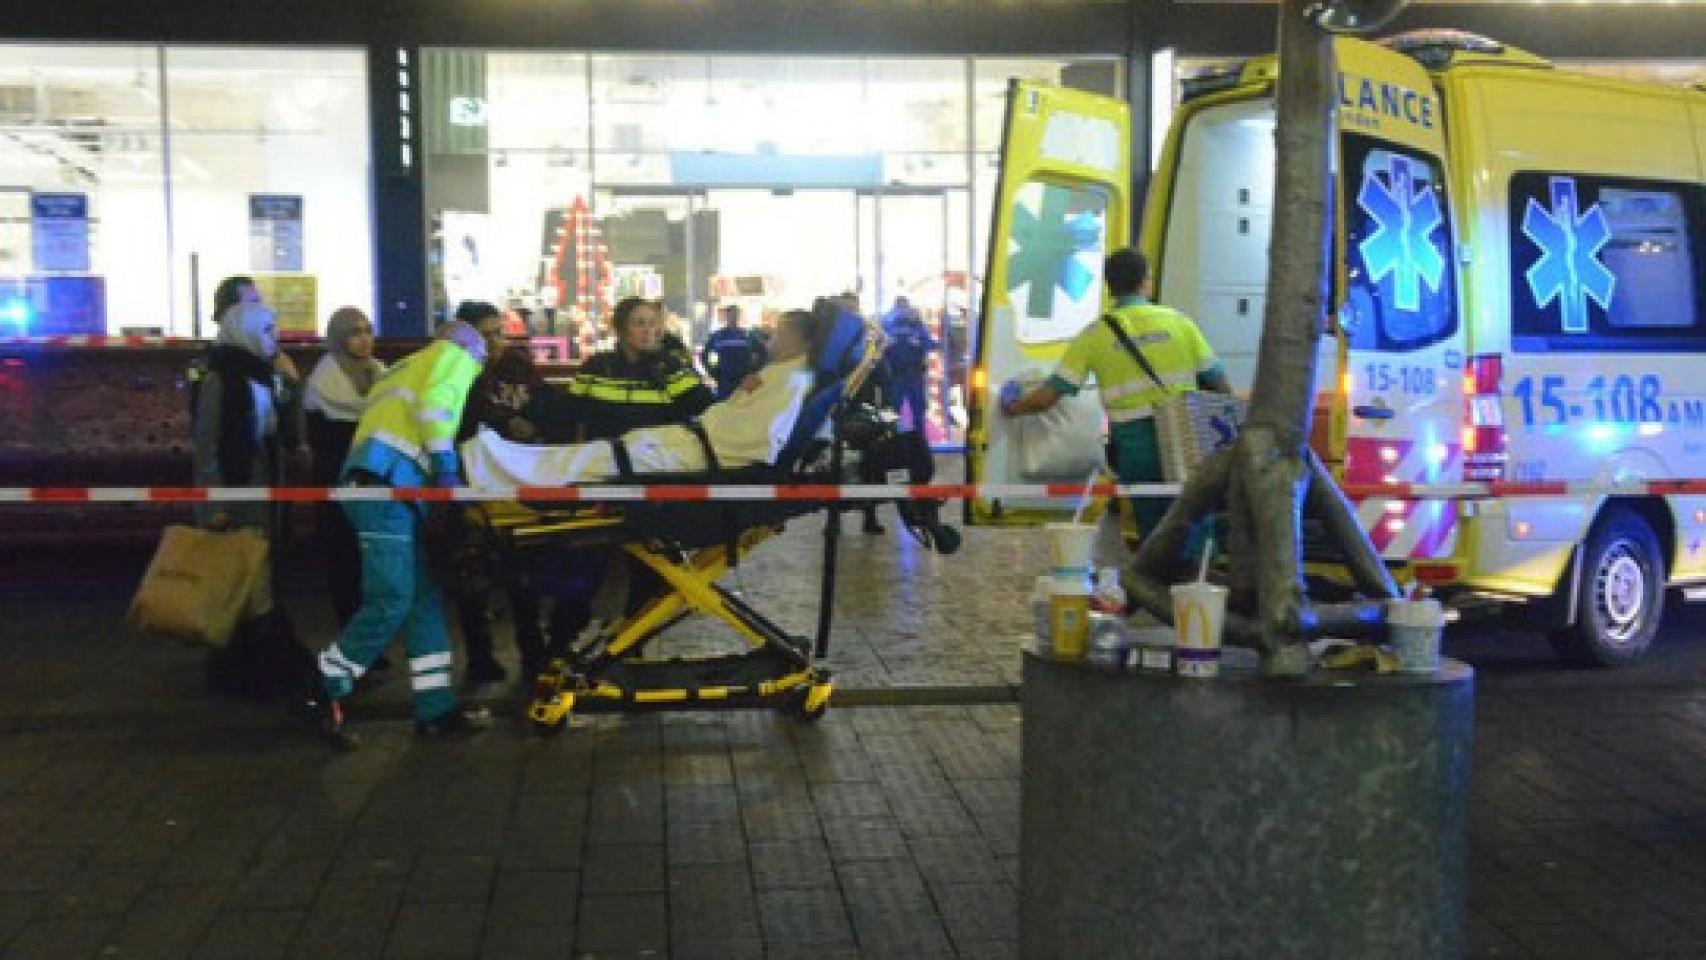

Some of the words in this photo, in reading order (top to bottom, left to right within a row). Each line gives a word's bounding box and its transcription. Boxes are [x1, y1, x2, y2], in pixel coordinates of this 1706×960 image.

[1338, 72, 1433, 130] LANCE
[1365, 364, 1434, 394] 15-108
[1513, 374, 1663, 430] 15-108
